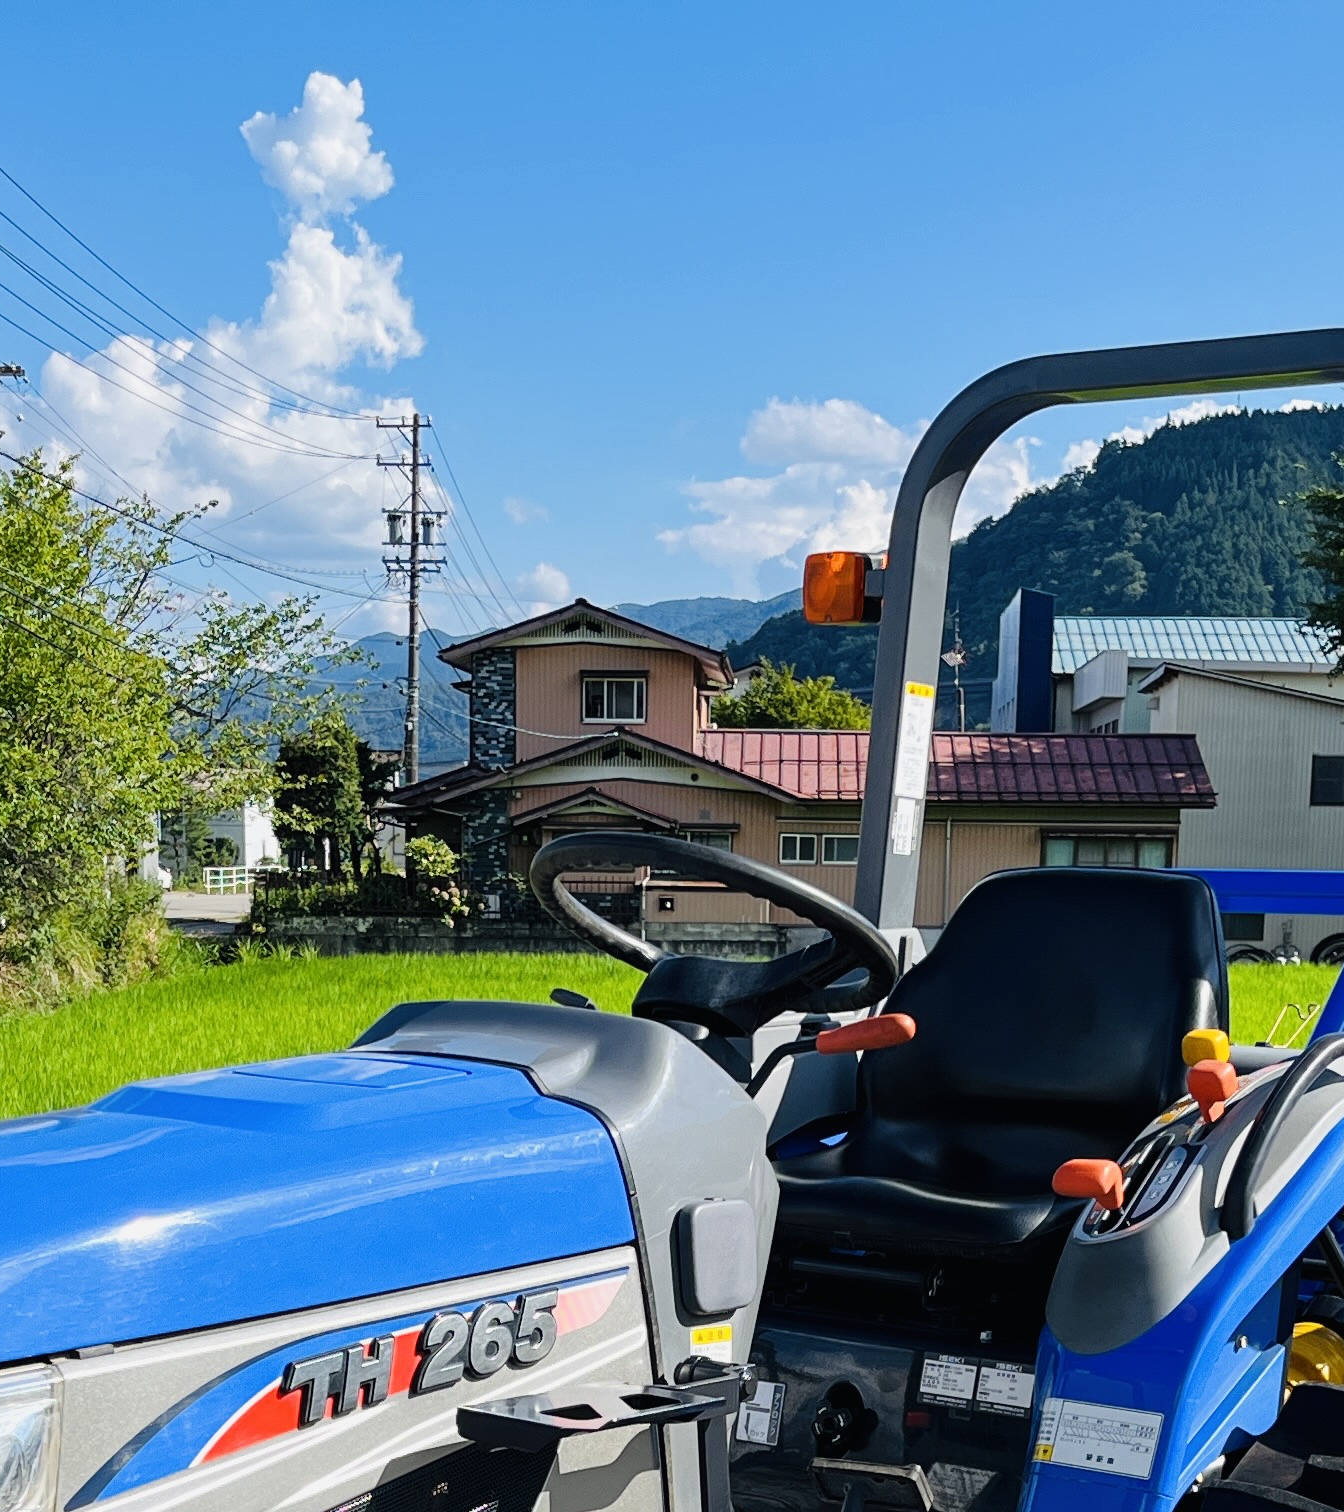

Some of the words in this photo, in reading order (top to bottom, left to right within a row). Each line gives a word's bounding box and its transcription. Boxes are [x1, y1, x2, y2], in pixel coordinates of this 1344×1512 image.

[280, 1334, 395, 1430] TH
[409, 1287, 560, 1399] 265
[938, 1354, 965, 1364] ISEKI
[995, 1362, 1023, 1373] ISEKI
